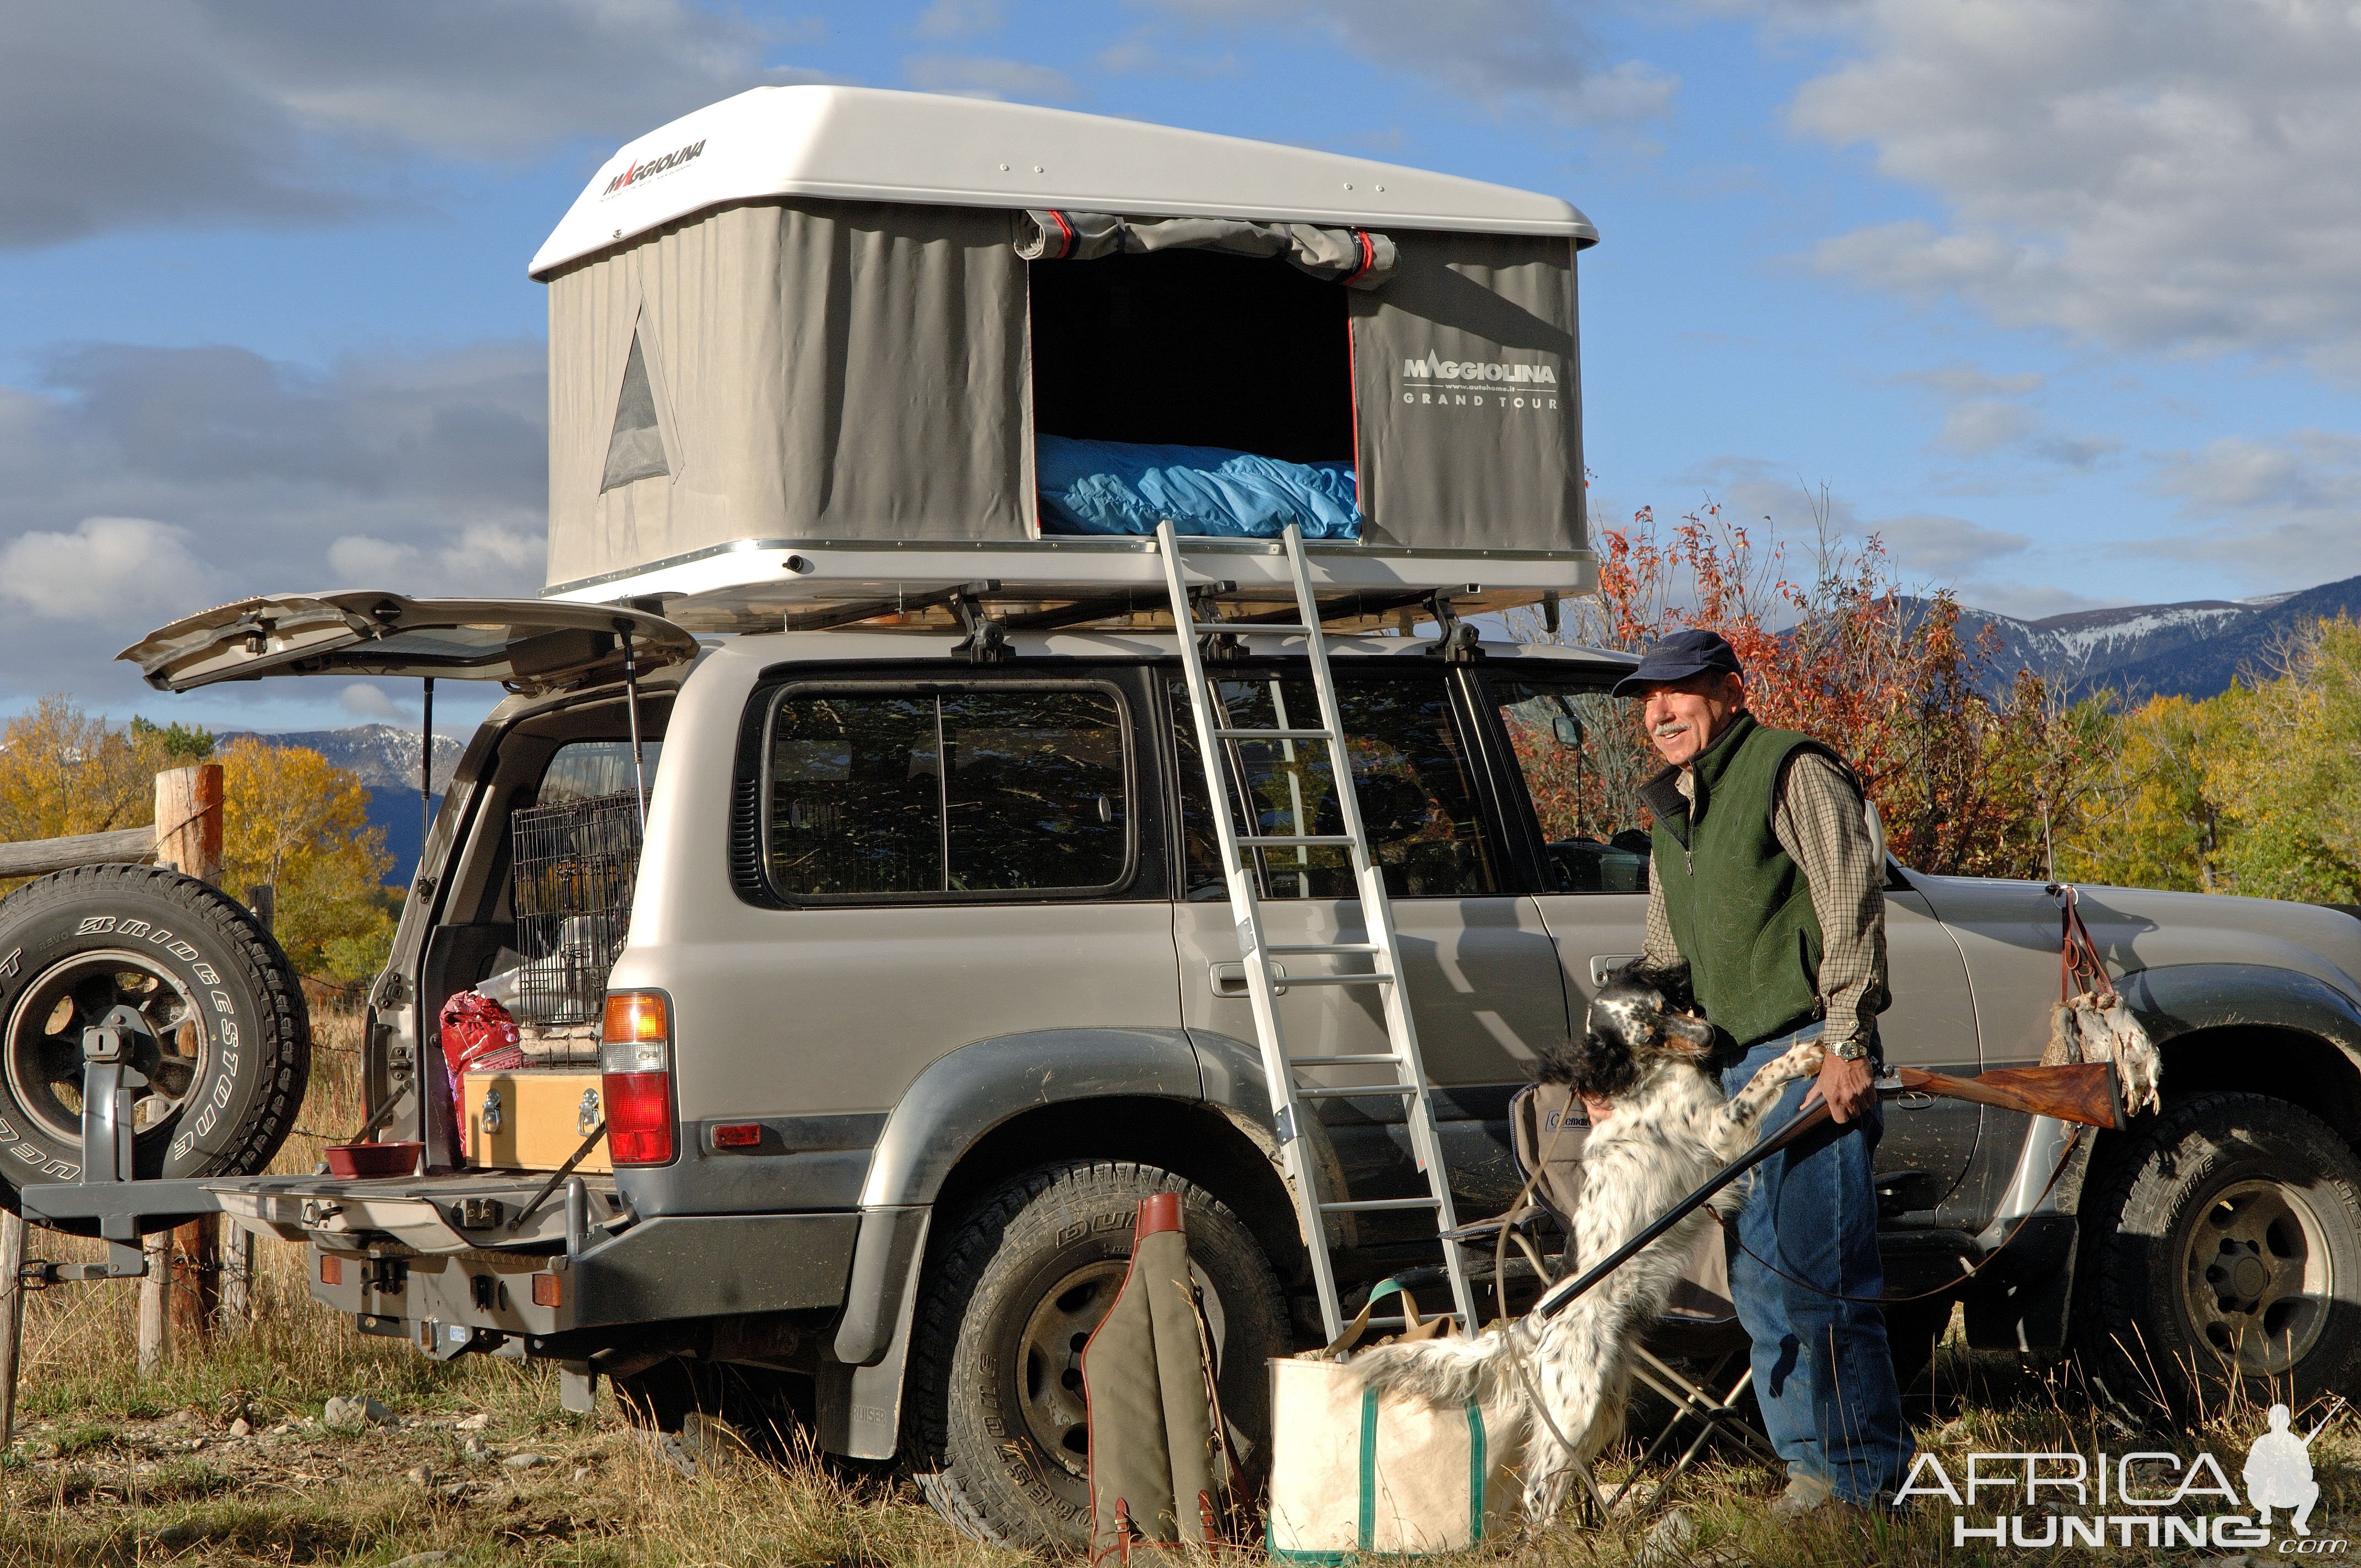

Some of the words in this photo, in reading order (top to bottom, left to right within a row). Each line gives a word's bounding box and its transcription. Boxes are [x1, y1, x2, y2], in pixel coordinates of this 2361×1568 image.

[602, 138, 707, 196] MAGGIOLINA
[1403, 348, 1557, 384] MAGGIOLINA
[1402, 392, 1483, 406] GRAND
[1499, 396, 1558, 410] TOUR
[1445, 383, 1516, 393] www.autohome.it
[75, 916, 240, 1161] BRIDGESTONE
